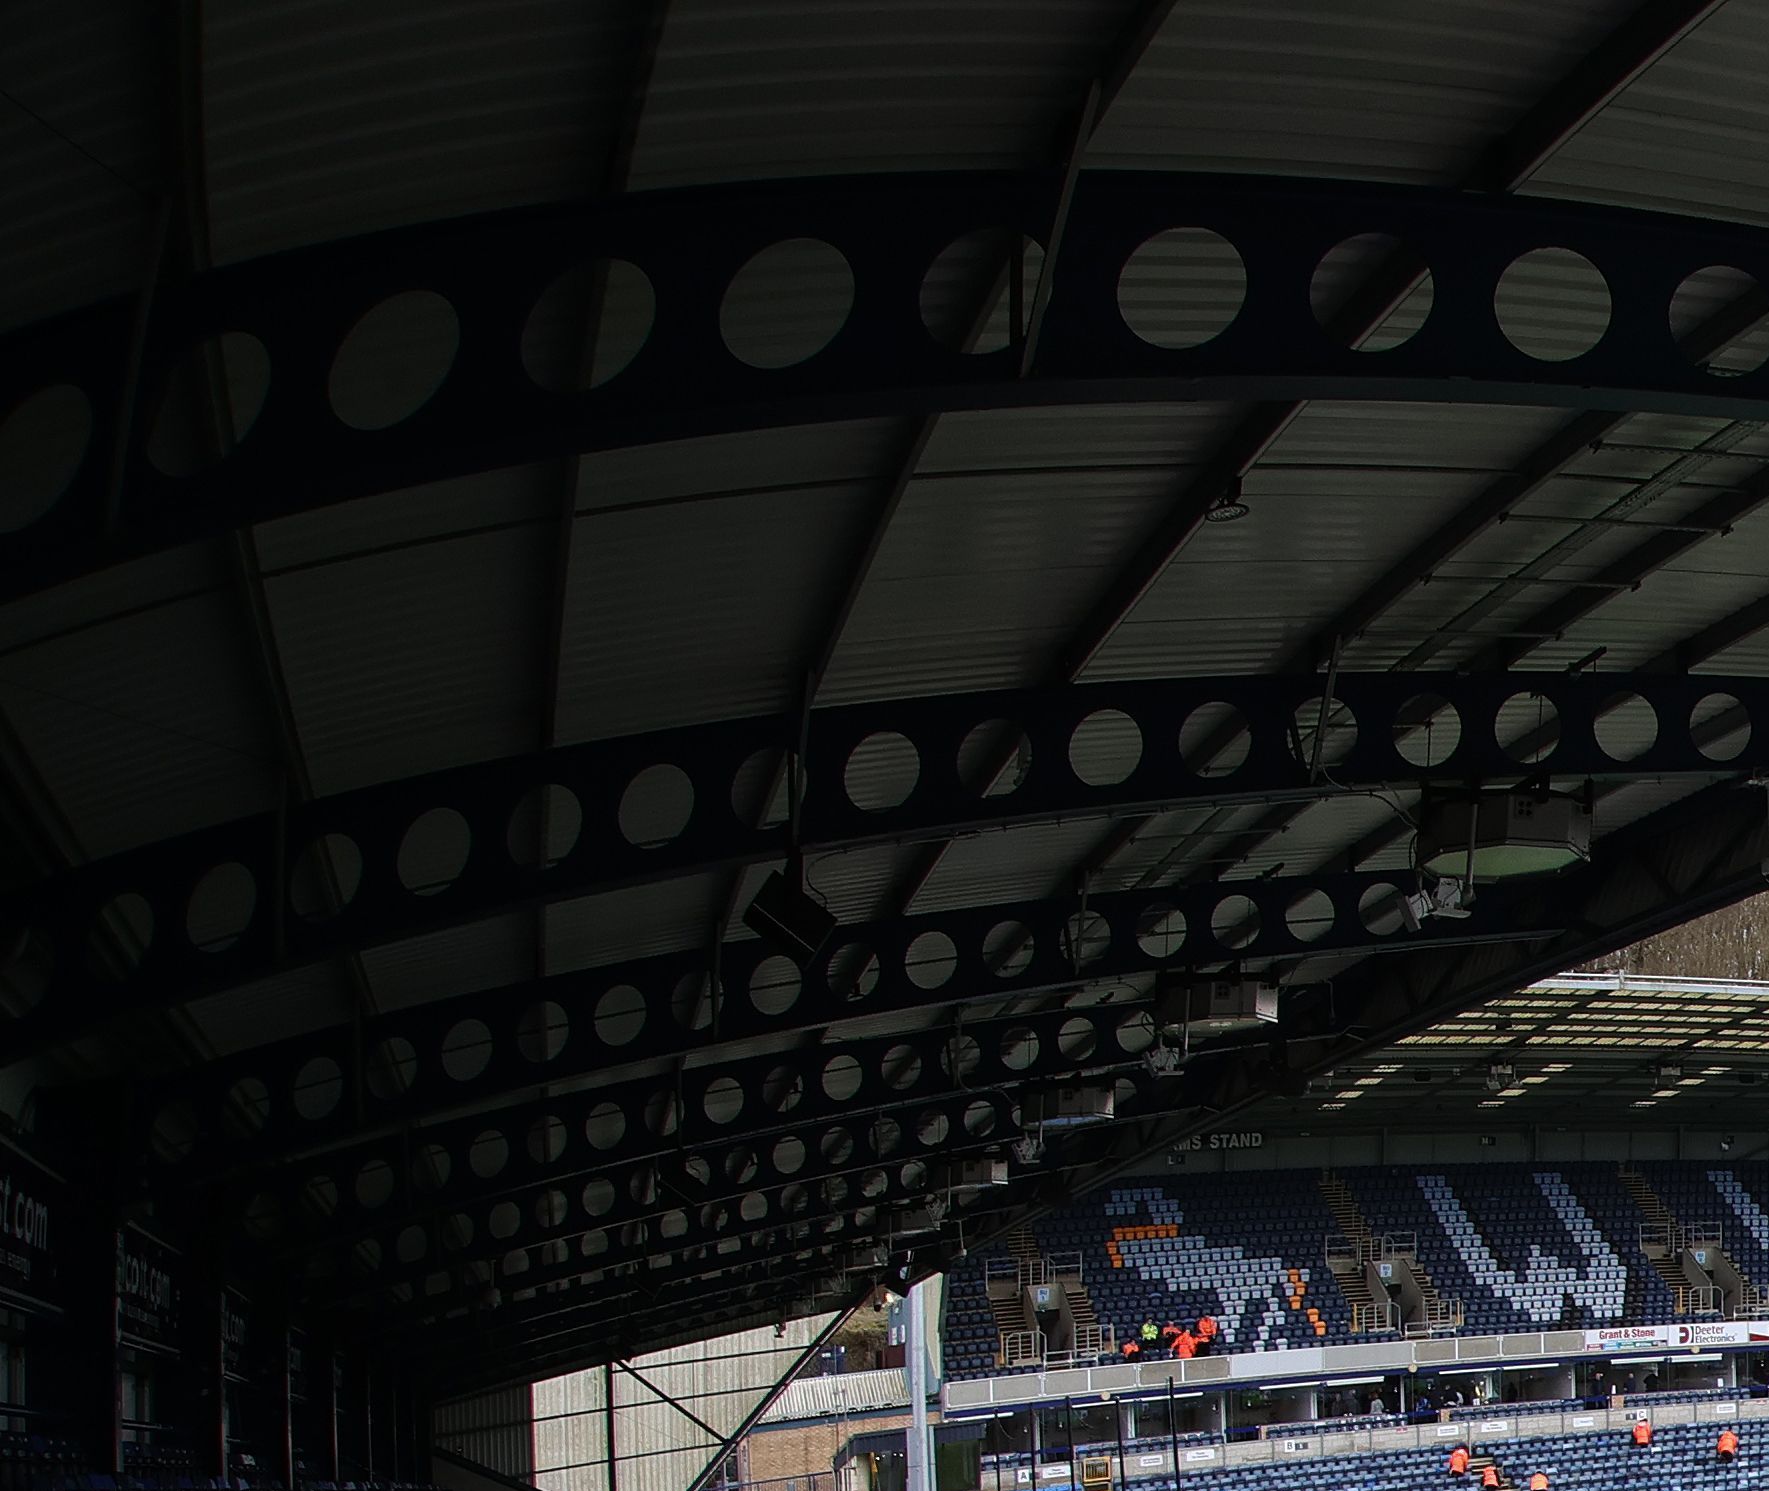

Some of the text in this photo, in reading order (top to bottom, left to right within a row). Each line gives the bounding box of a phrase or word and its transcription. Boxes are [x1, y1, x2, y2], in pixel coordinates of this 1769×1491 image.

[1209, 1133, 1262, 1149] STAND
[1599, 1327, 1655, 1340] Grant & Stone
[1695, 1325, 1724, 1335] Deeter
[1695, 1333, 1735, 1343] Electronics
